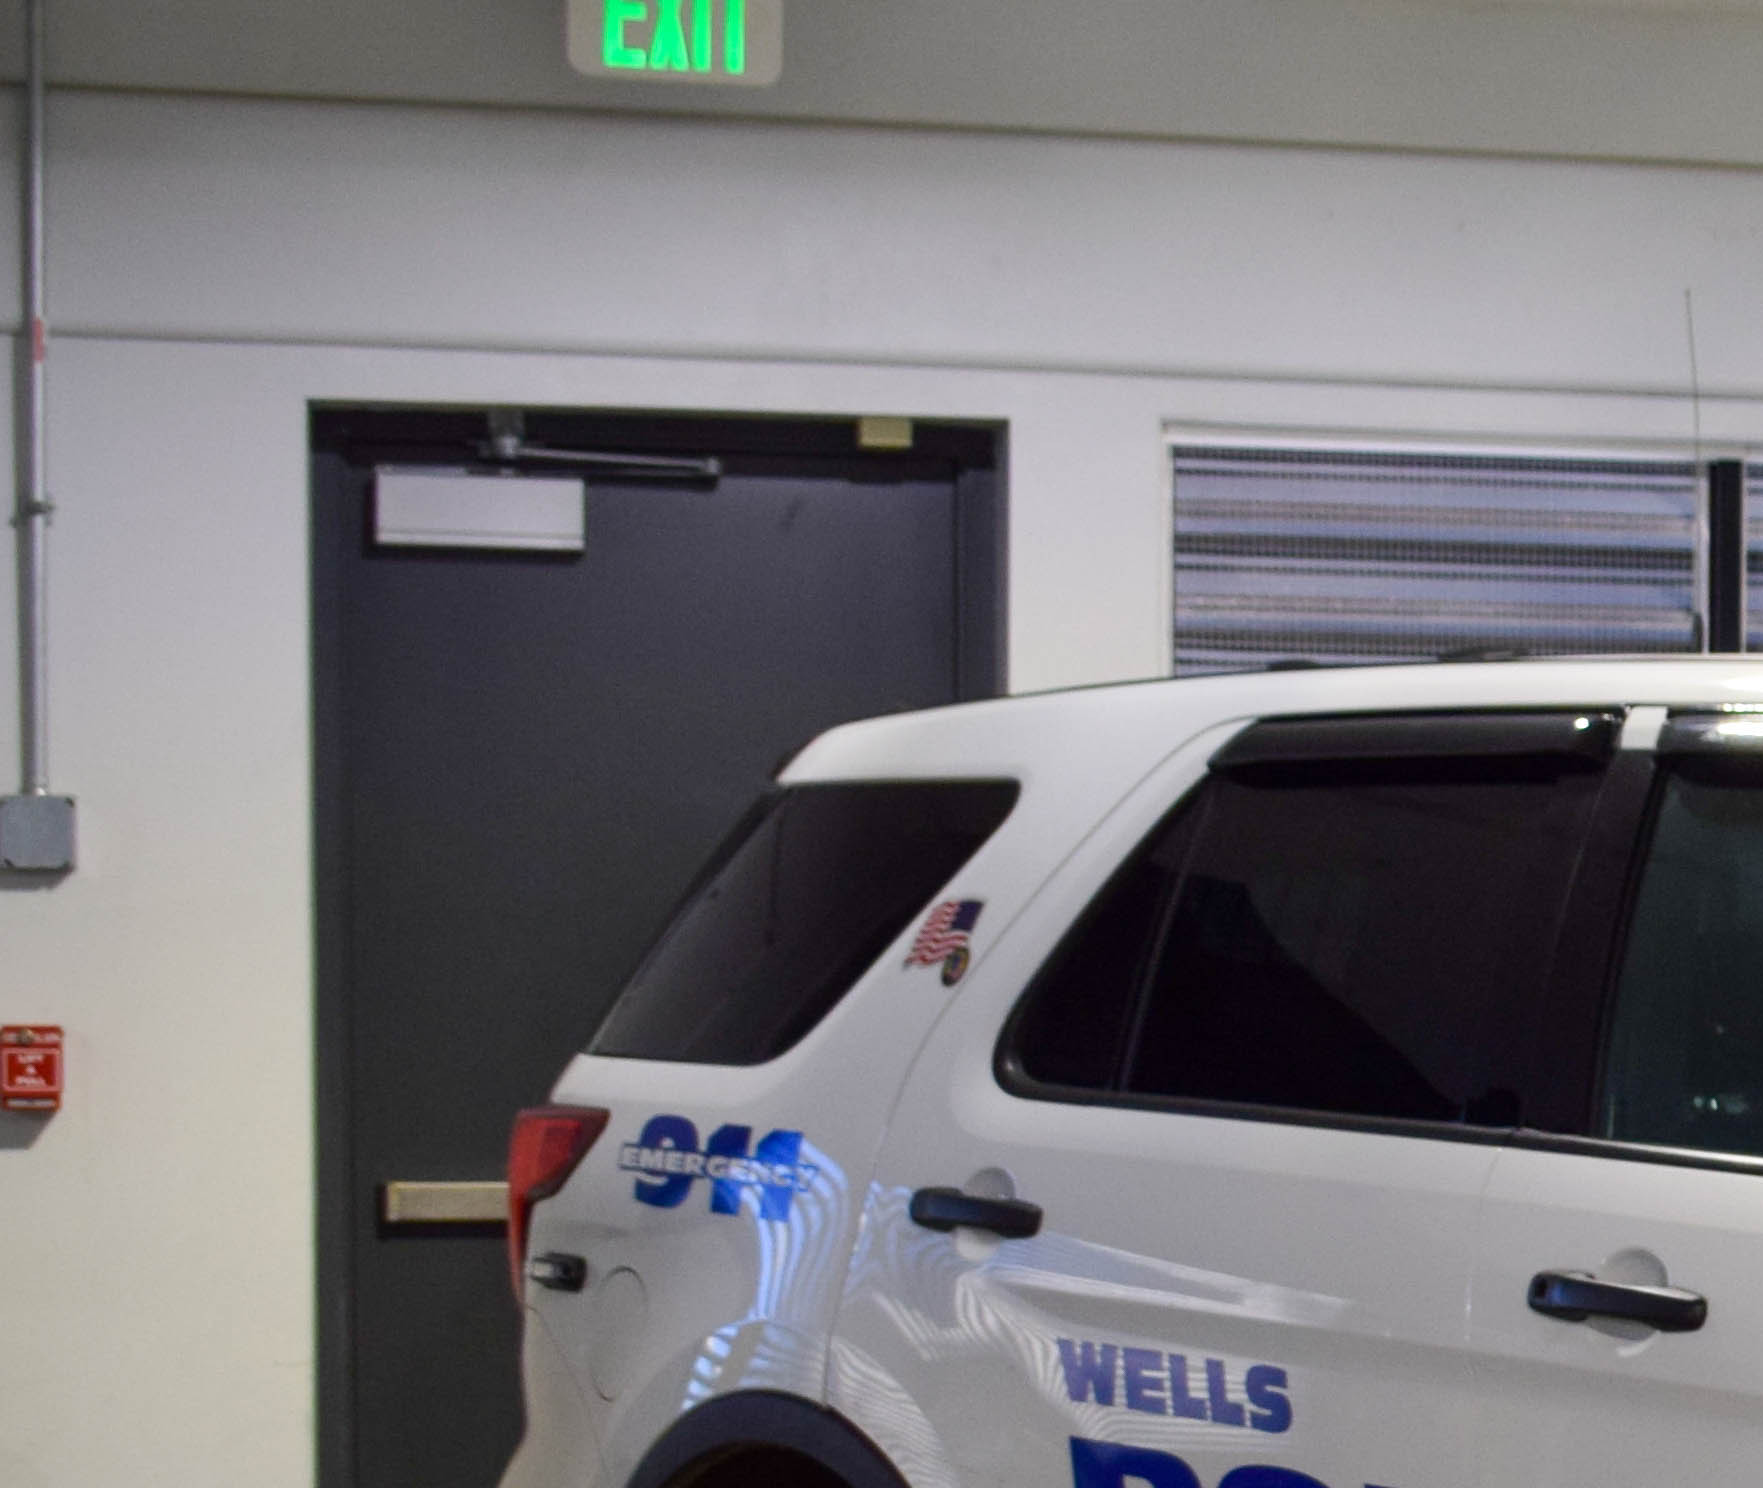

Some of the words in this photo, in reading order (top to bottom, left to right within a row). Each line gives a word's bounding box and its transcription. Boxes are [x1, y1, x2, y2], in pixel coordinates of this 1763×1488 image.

[617, 1142, 820, 1192] EMERGENCY
[634, 1113, 804, 1222] 911
[1056, 1336, 1293, 1434] WELLS
